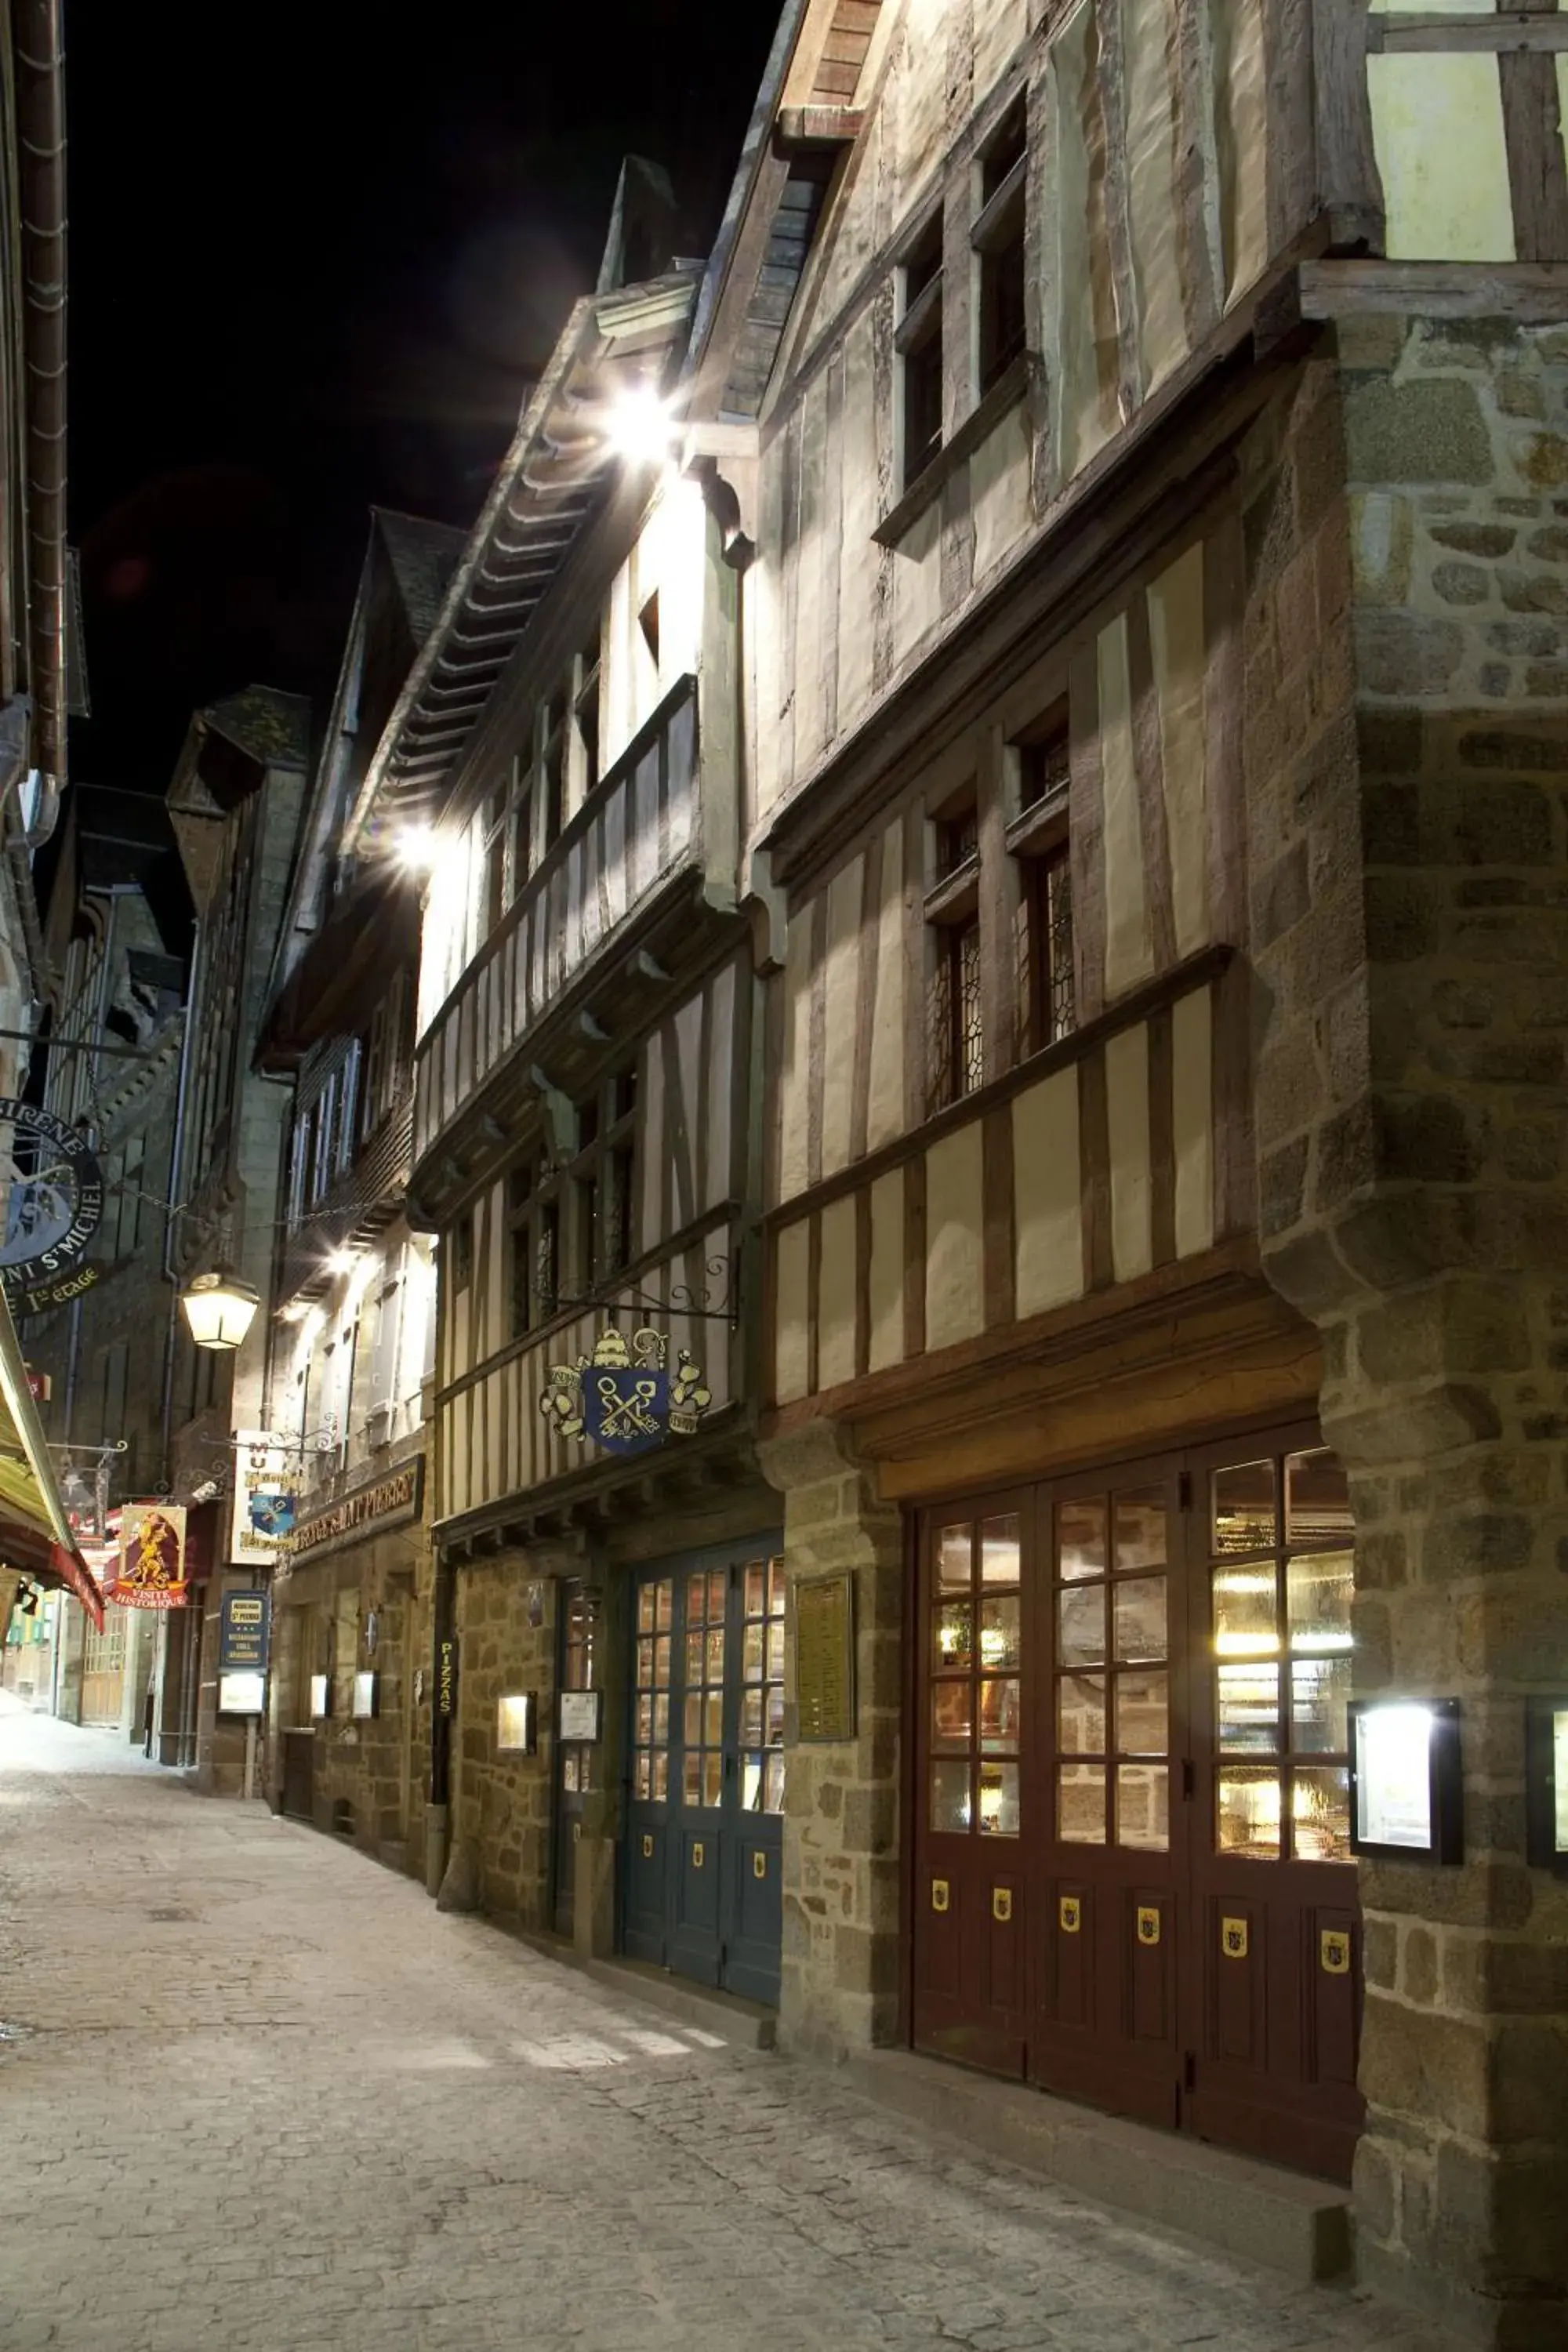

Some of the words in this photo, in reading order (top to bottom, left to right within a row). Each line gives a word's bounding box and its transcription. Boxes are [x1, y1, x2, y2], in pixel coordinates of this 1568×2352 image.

[58, 1179, 102, 1256] MICHEL
[115, 1592, 185, 1609] HISTORIQUE
[132, 1588, 170, 1599] VISITE
[439, 1642, 452, 1713] PIZZAS
